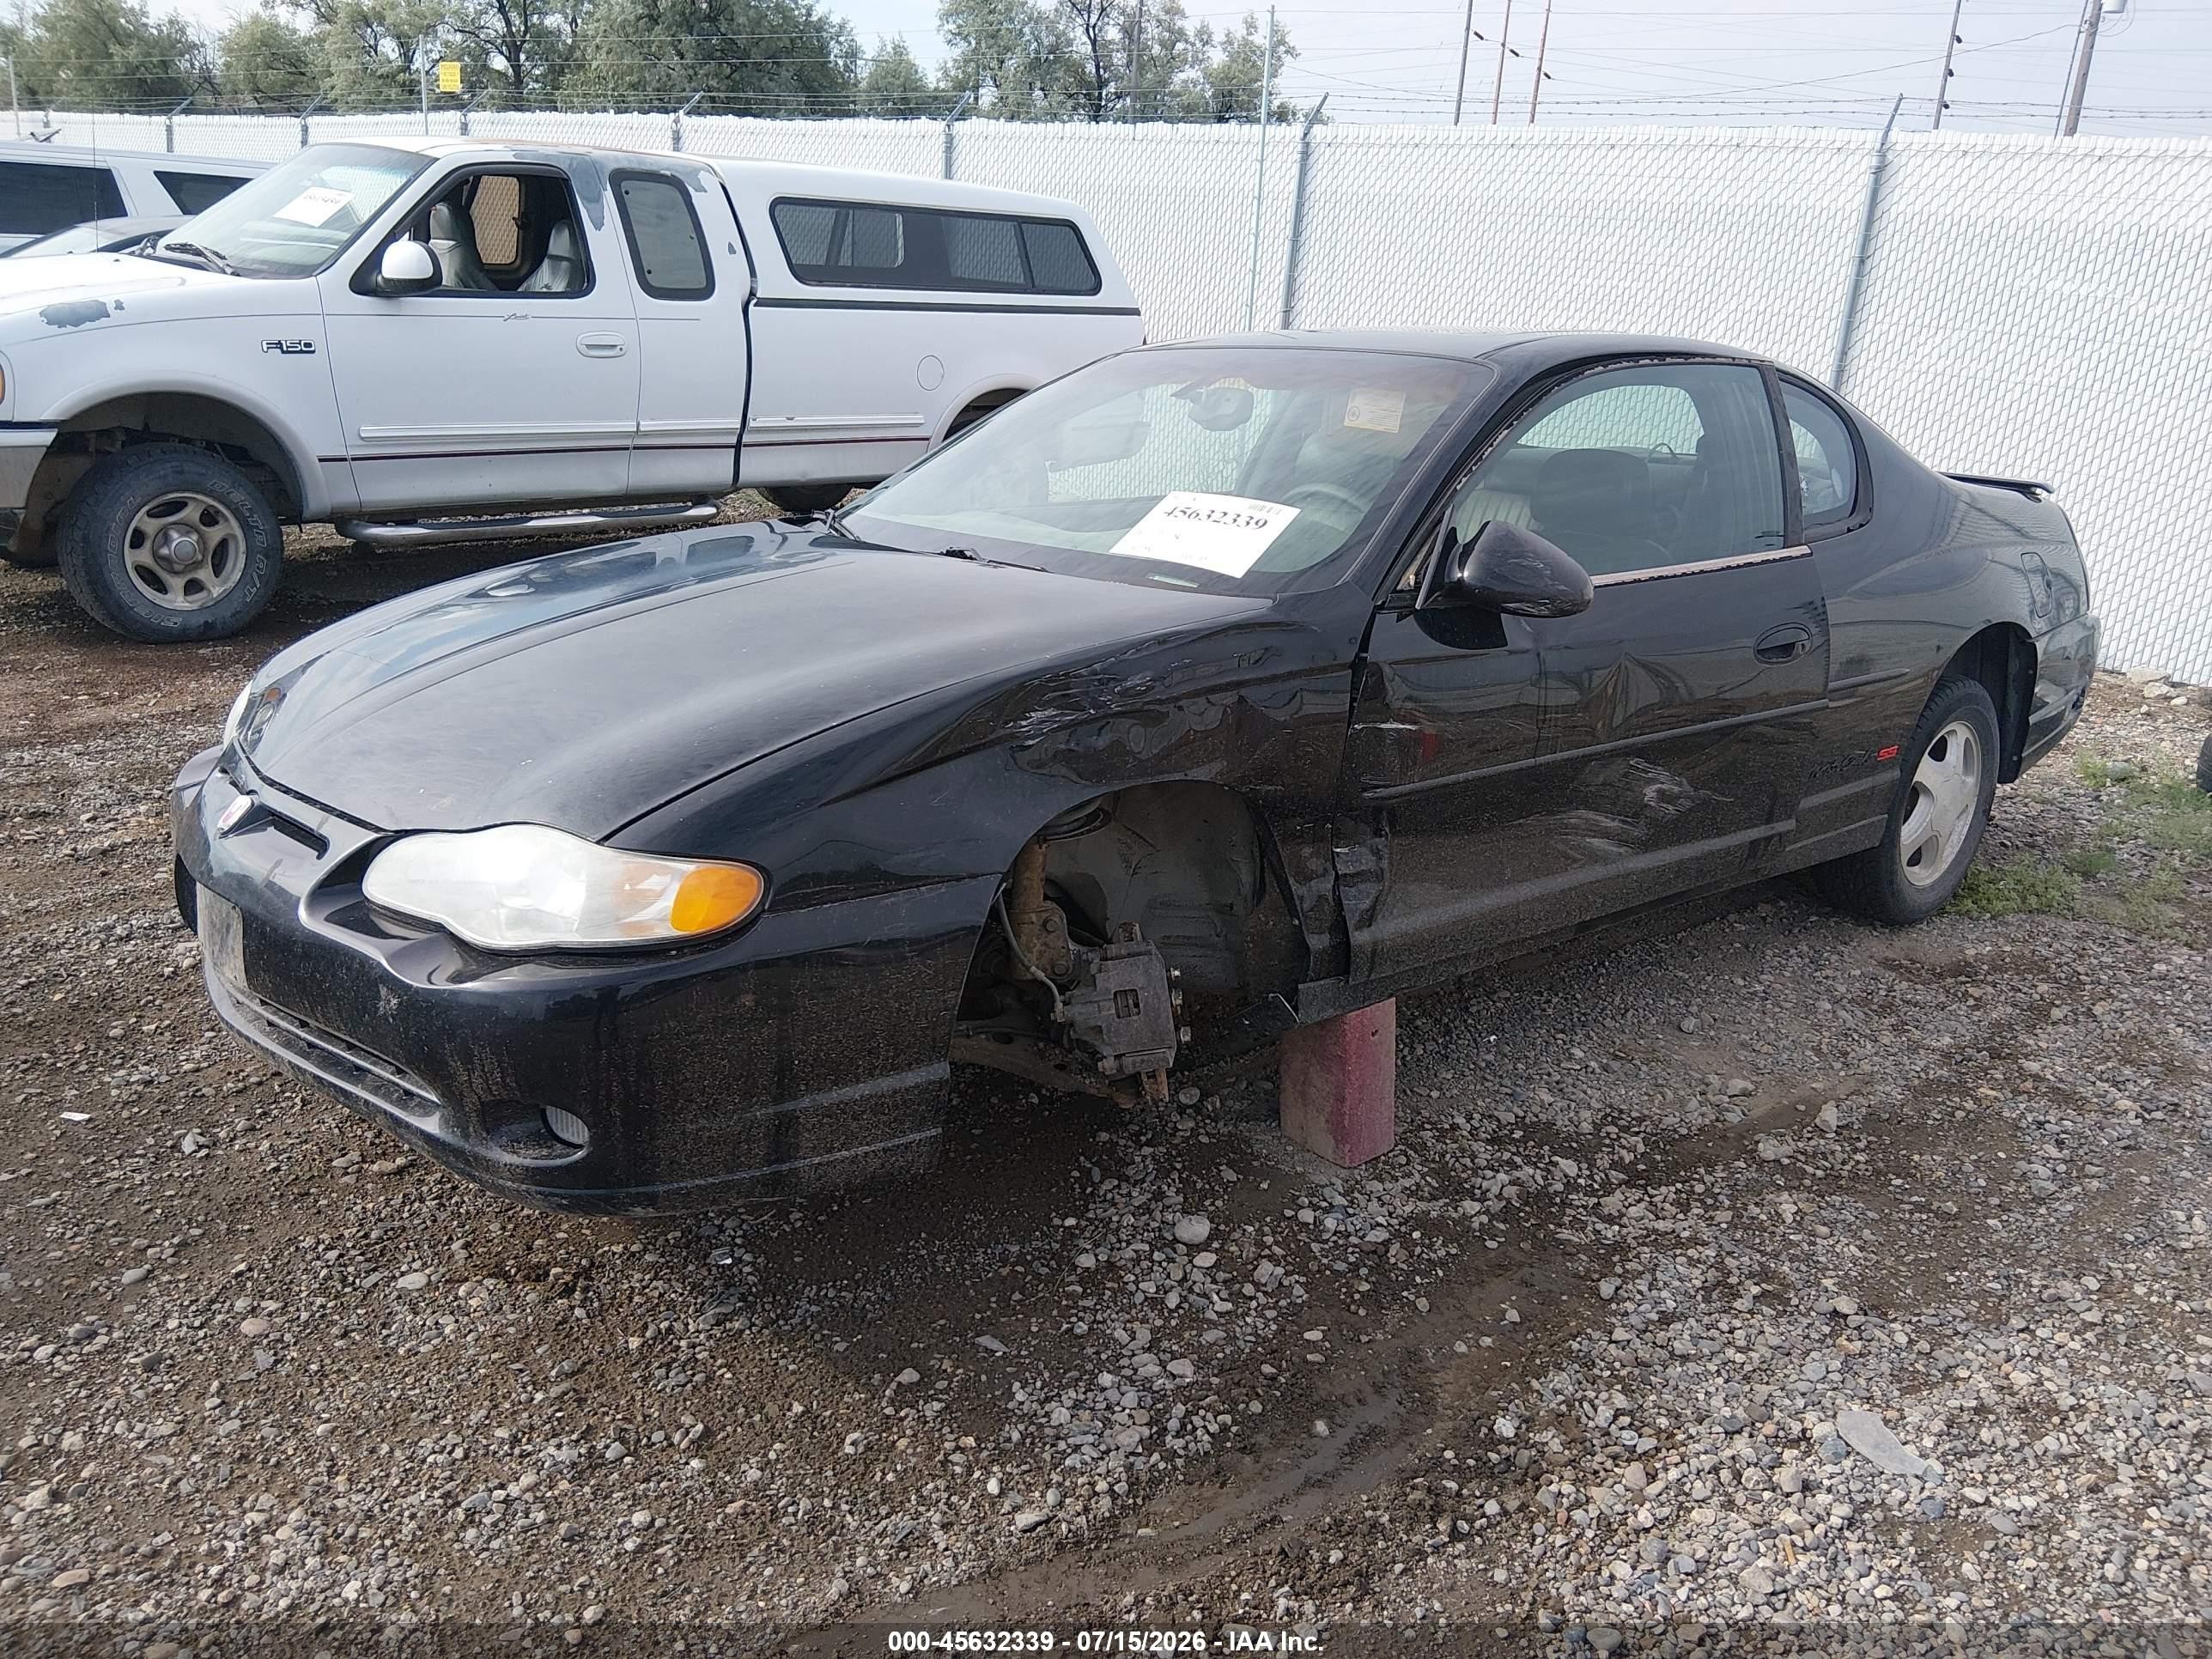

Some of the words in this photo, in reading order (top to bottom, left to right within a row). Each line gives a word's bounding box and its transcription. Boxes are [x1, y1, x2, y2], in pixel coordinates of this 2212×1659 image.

[261, 340, 315, 354] F-150
[208, 480, 267, 548] DELTA
[1164, 506, 1268, 530] 45632339
[244, 555, 267, 602] A/T
[1875, 744, 1900, 762] SS
